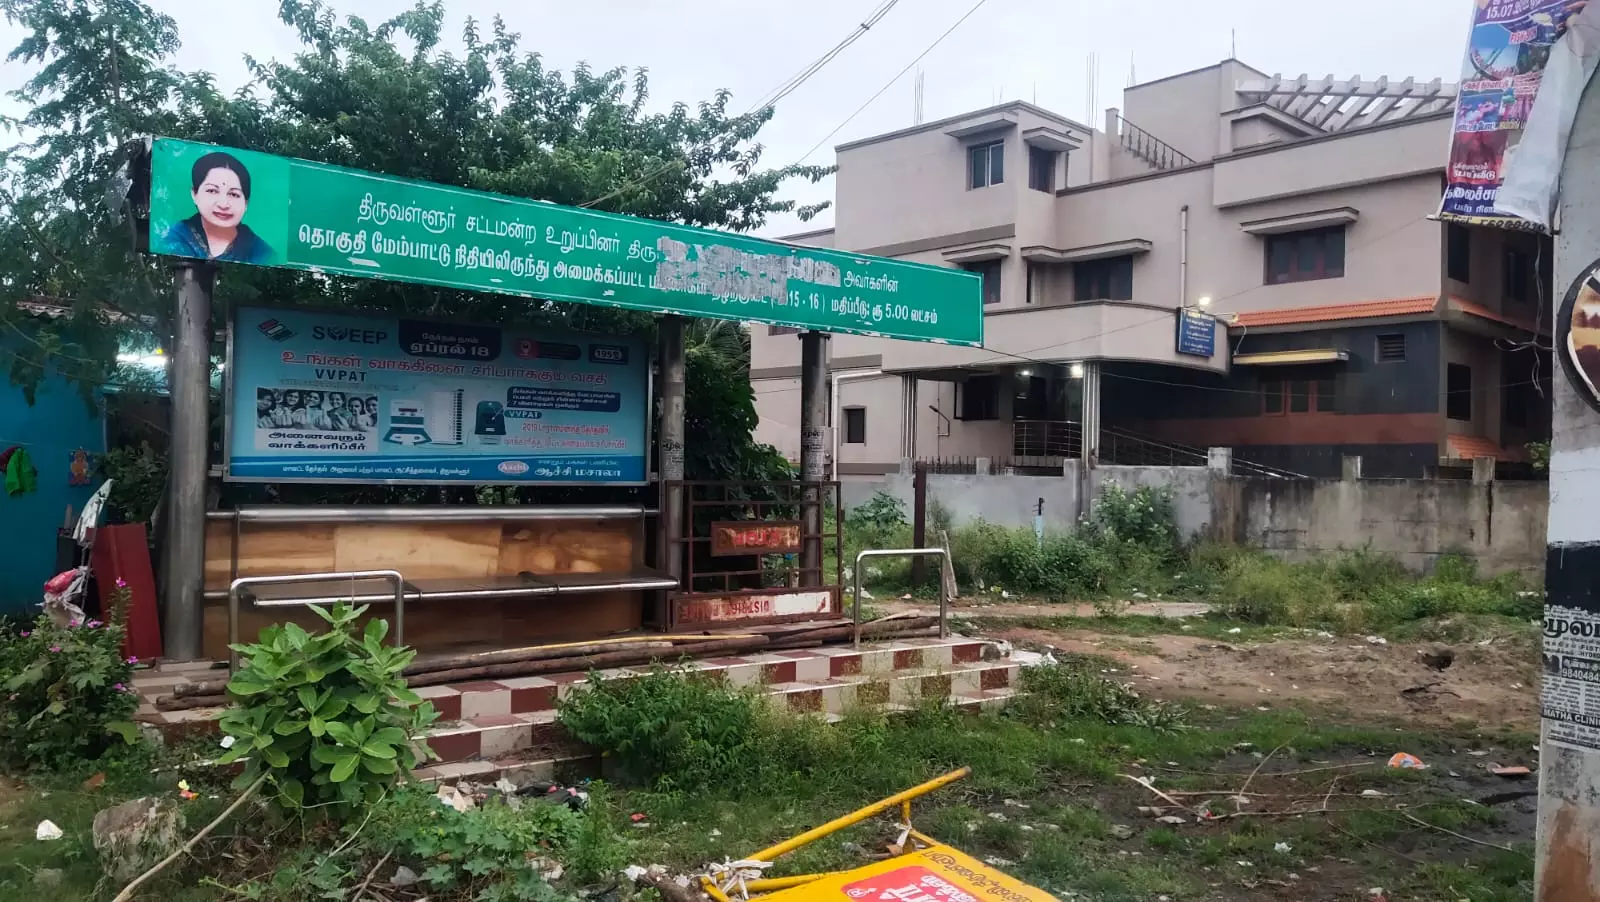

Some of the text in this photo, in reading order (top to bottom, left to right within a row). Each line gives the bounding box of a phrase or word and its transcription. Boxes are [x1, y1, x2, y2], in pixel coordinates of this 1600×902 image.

[357, 192, 456, 233] திருவள்ளூர்
[466, 214, 537, 246] சட்டமன்ற
[545, 225, 620, 253] உறுப்பினர்
[843, 271, 899, 292] அவர்களின்
[299, 223, 366, 255] தொகுதி
[372, 230, 451, 267] மேம்பாட்டு
[455, 245, 549, 282] நிதியிலிருந்து
[553, 262, 645, 290] அமைக்கப்பட்ட
[885, 303, 909, 320] 5.00
[911, 308, 938, 324] லட்சம்
[410, 342, 490, 357] ஏப்ரல் 18
[281, 351, 362, 369] உங்கள்
[315, 368, 368, 382] VVPAT
[509, 410, 539, 418] VVPAT
[269, 432, 366, 441] அனைவரும்
[534, 466, 621, 477] ஆச்சி மசாலா
[1543, 708, 1572, 721] MATHA
